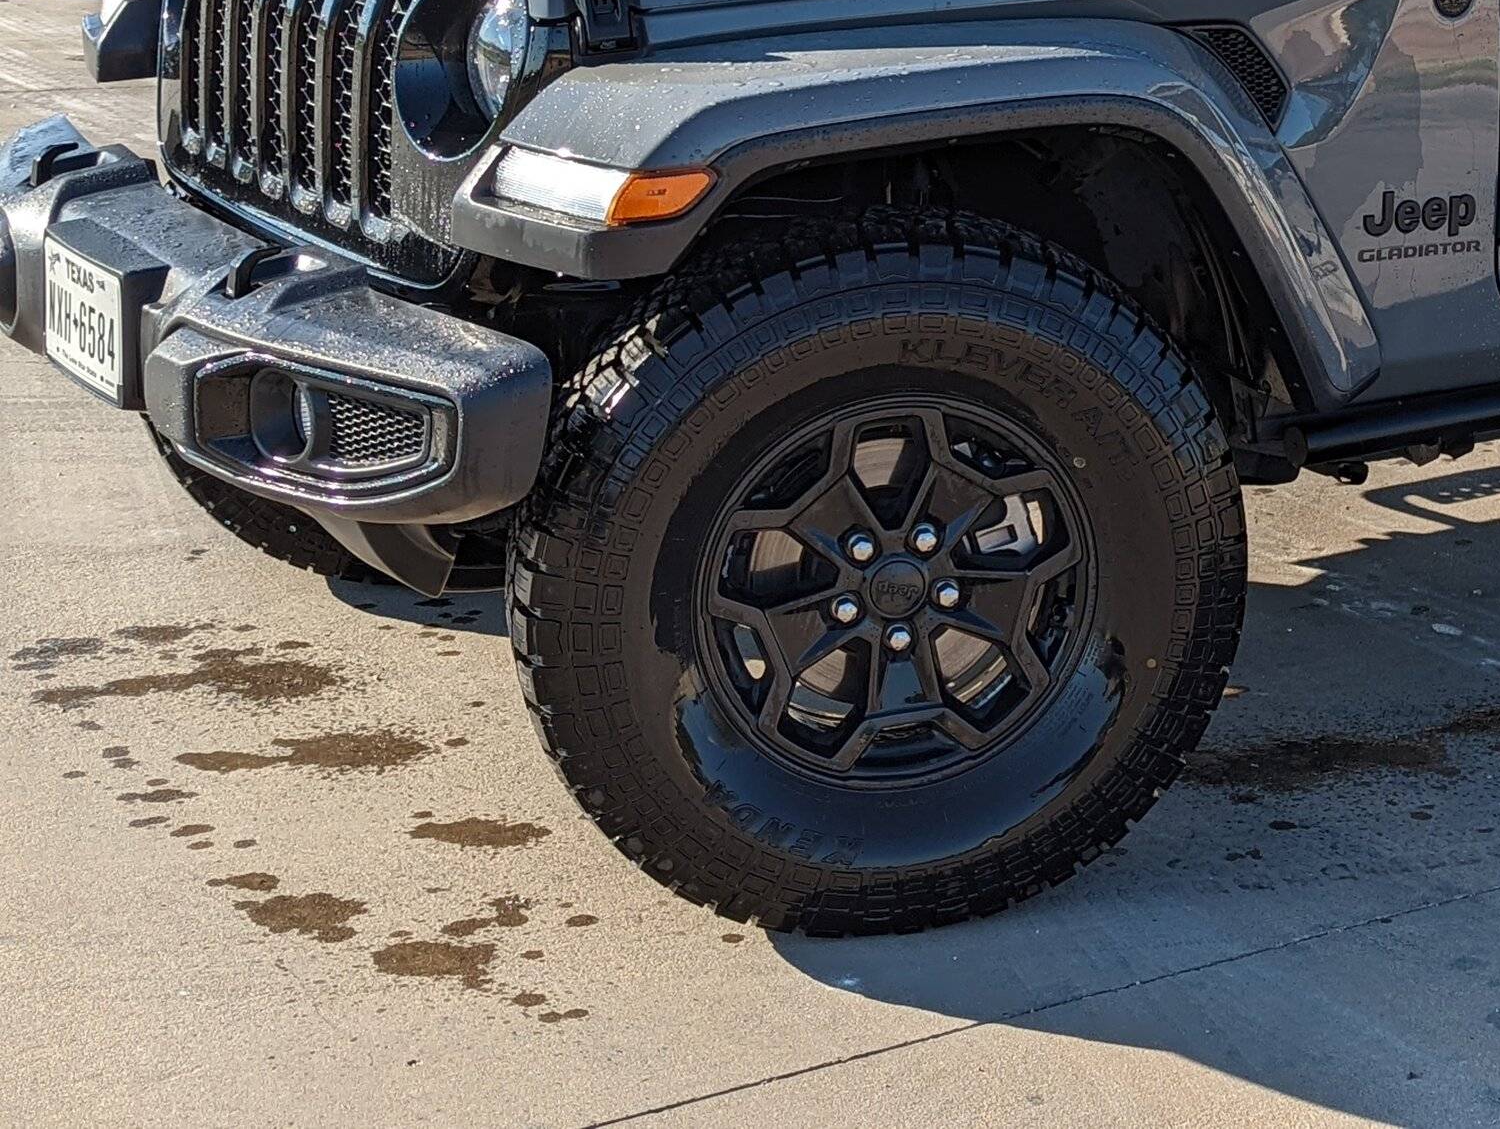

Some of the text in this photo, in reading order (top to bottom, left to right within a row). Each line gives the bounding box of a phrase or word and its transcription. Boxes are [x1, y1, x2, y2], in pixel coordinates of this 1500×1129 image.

[1363, 190, 1476, 237] Jeep
[1357, 240, 1481, 263] GLADIATOR
[65, 258, 95, 294] TEXAS
[898, 338, 1078, 410] KLEVER
